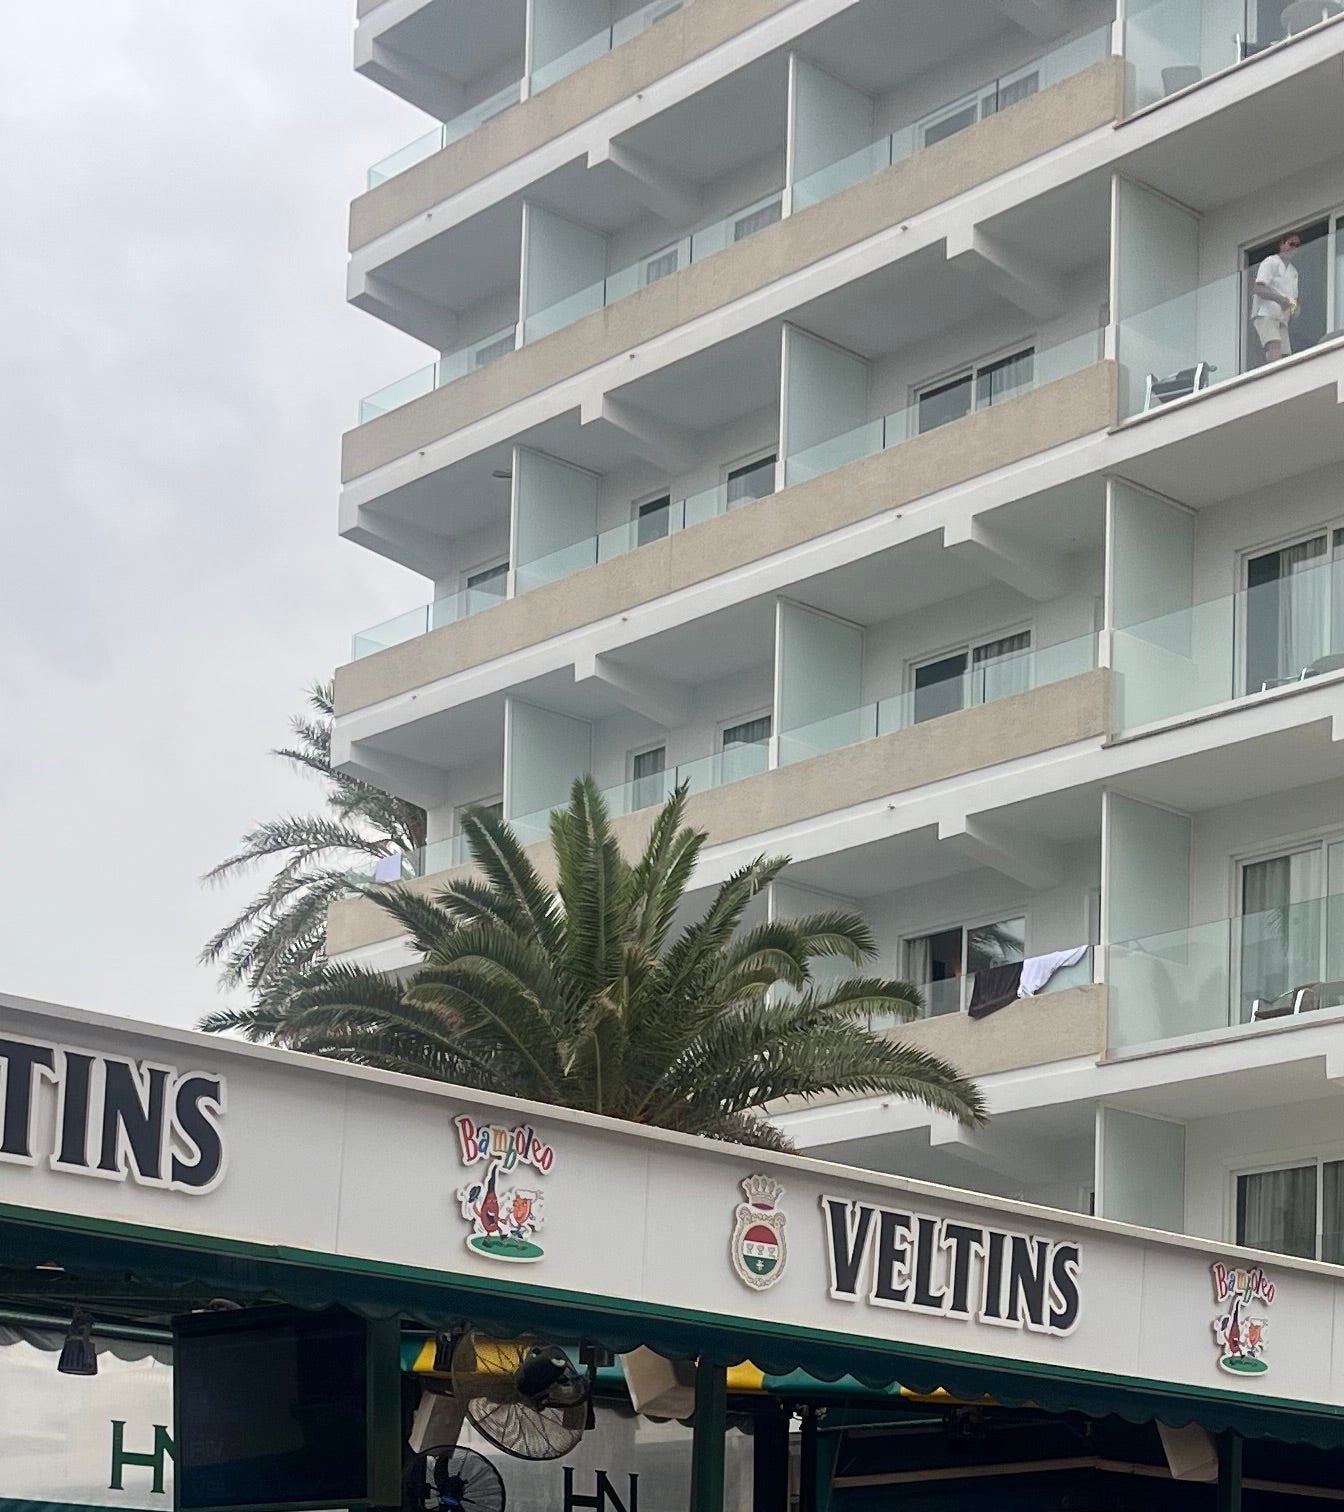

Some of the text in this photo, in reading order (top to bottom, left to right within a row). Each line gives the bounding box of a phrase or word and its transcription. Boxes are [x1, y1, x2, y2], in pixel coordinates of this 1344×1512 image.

[458, 1118, 554, 1171] Bamboleo
[823, 1197, 1081, 1332] VELTINS
[1216, 1264, 1275, 1303] Bamboleo
